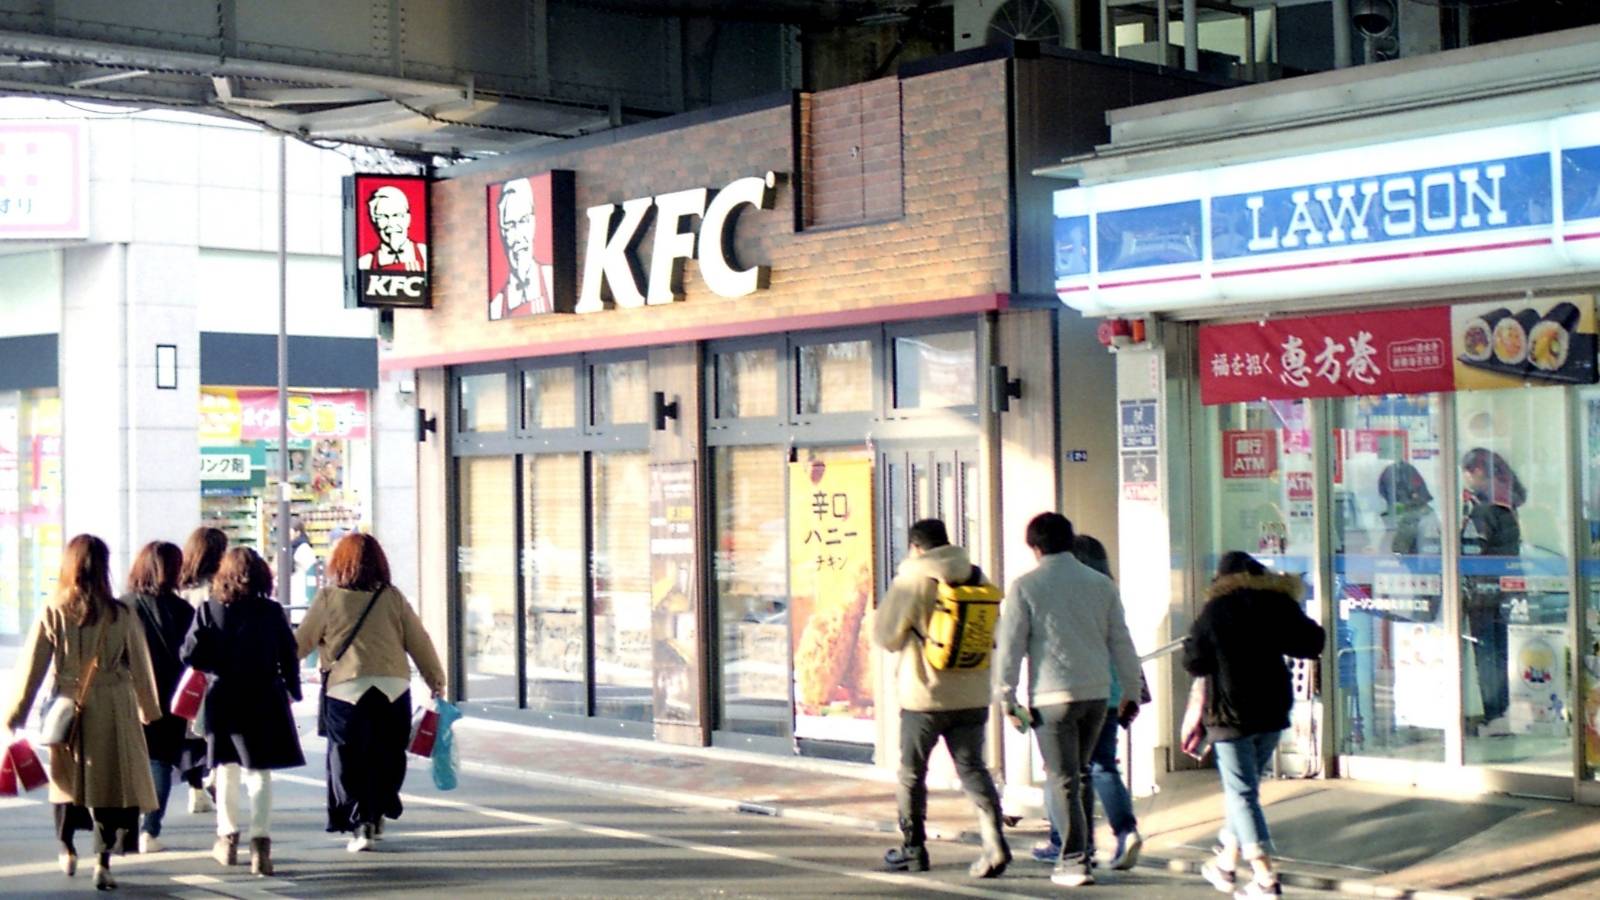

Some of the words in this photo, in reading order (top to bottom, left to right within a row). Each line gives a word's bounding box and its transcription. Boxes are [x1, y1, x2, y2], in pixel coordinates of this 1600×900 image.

[1246, 164, 1507, 251] LAWSON
[575, 177, 767, 313] KFC
[366, 274, 424, 297] KFC
[1279, 331, 1381, 388] 恵方巻
[1233, 457, 1266, 472] ATM
[811, 490, 848, 521] 辛口
[804, 528, 858, 545] ハニー
[815, 555, 848, 571] チキン
